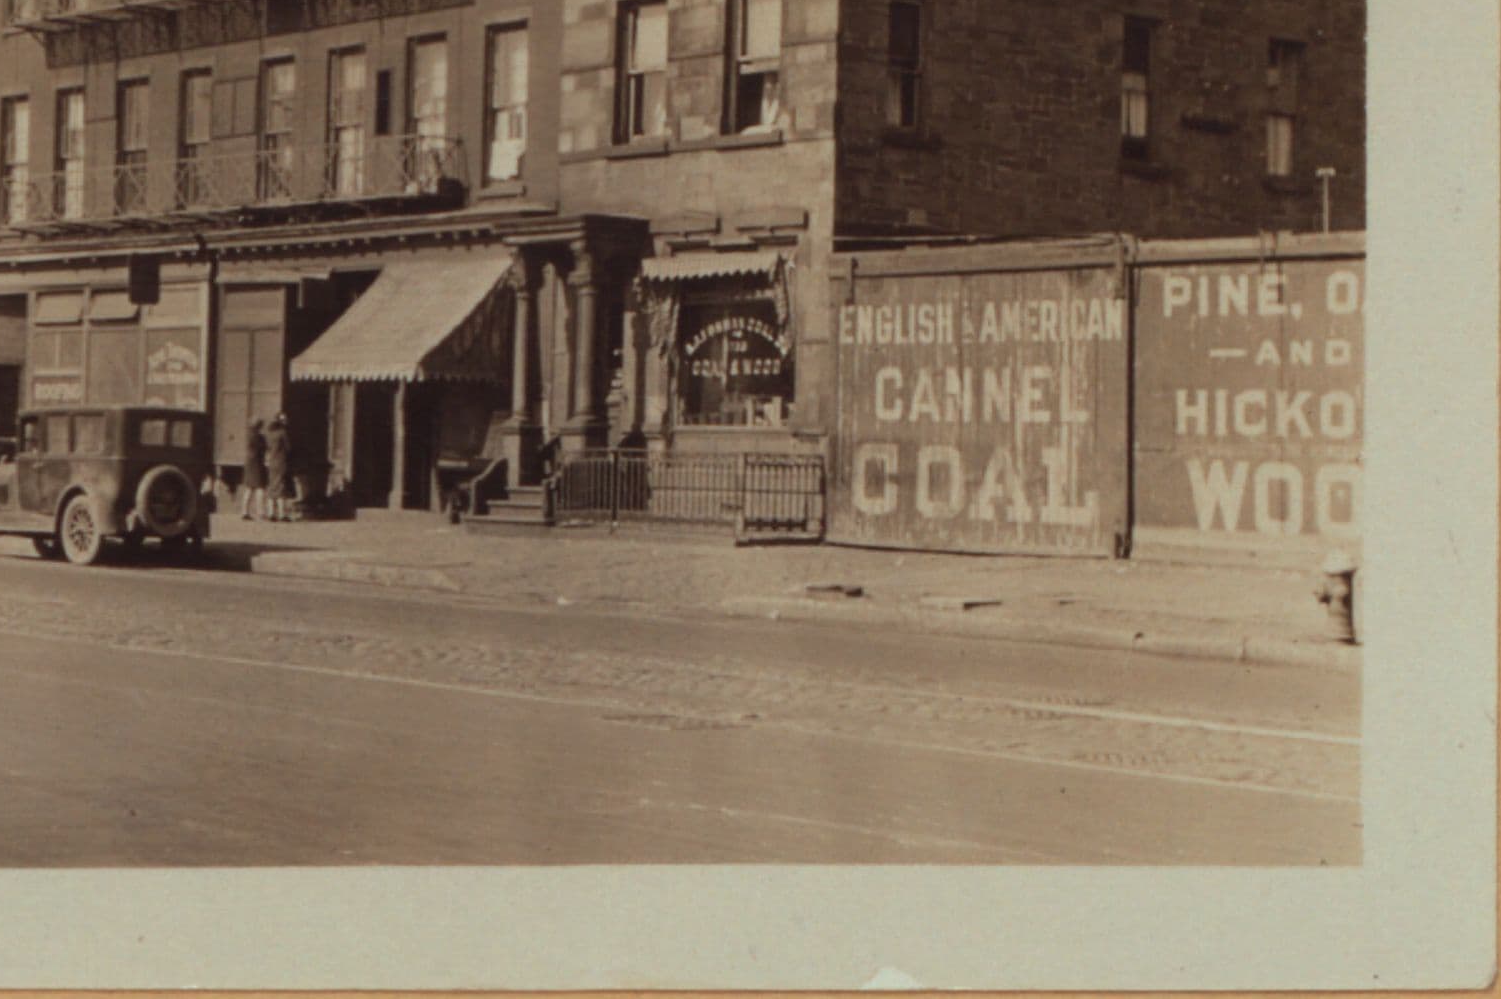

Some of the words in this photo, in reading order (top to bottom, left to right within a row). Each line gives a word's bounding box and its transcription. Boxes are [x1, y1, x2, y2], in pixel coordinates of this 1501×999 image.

[838, 302, 954, 346] ENGLISH
[978, 298, 1124, 343] AMERICAN
[1163, 271, 1303, 321] PINE,
[874, 365, 1091, 424] CANNEL
[1175, 388, 1357, 439] HICKO
[853, 442, 1100, 525] COAL
[1185, 457, 1367, 535] WOO
